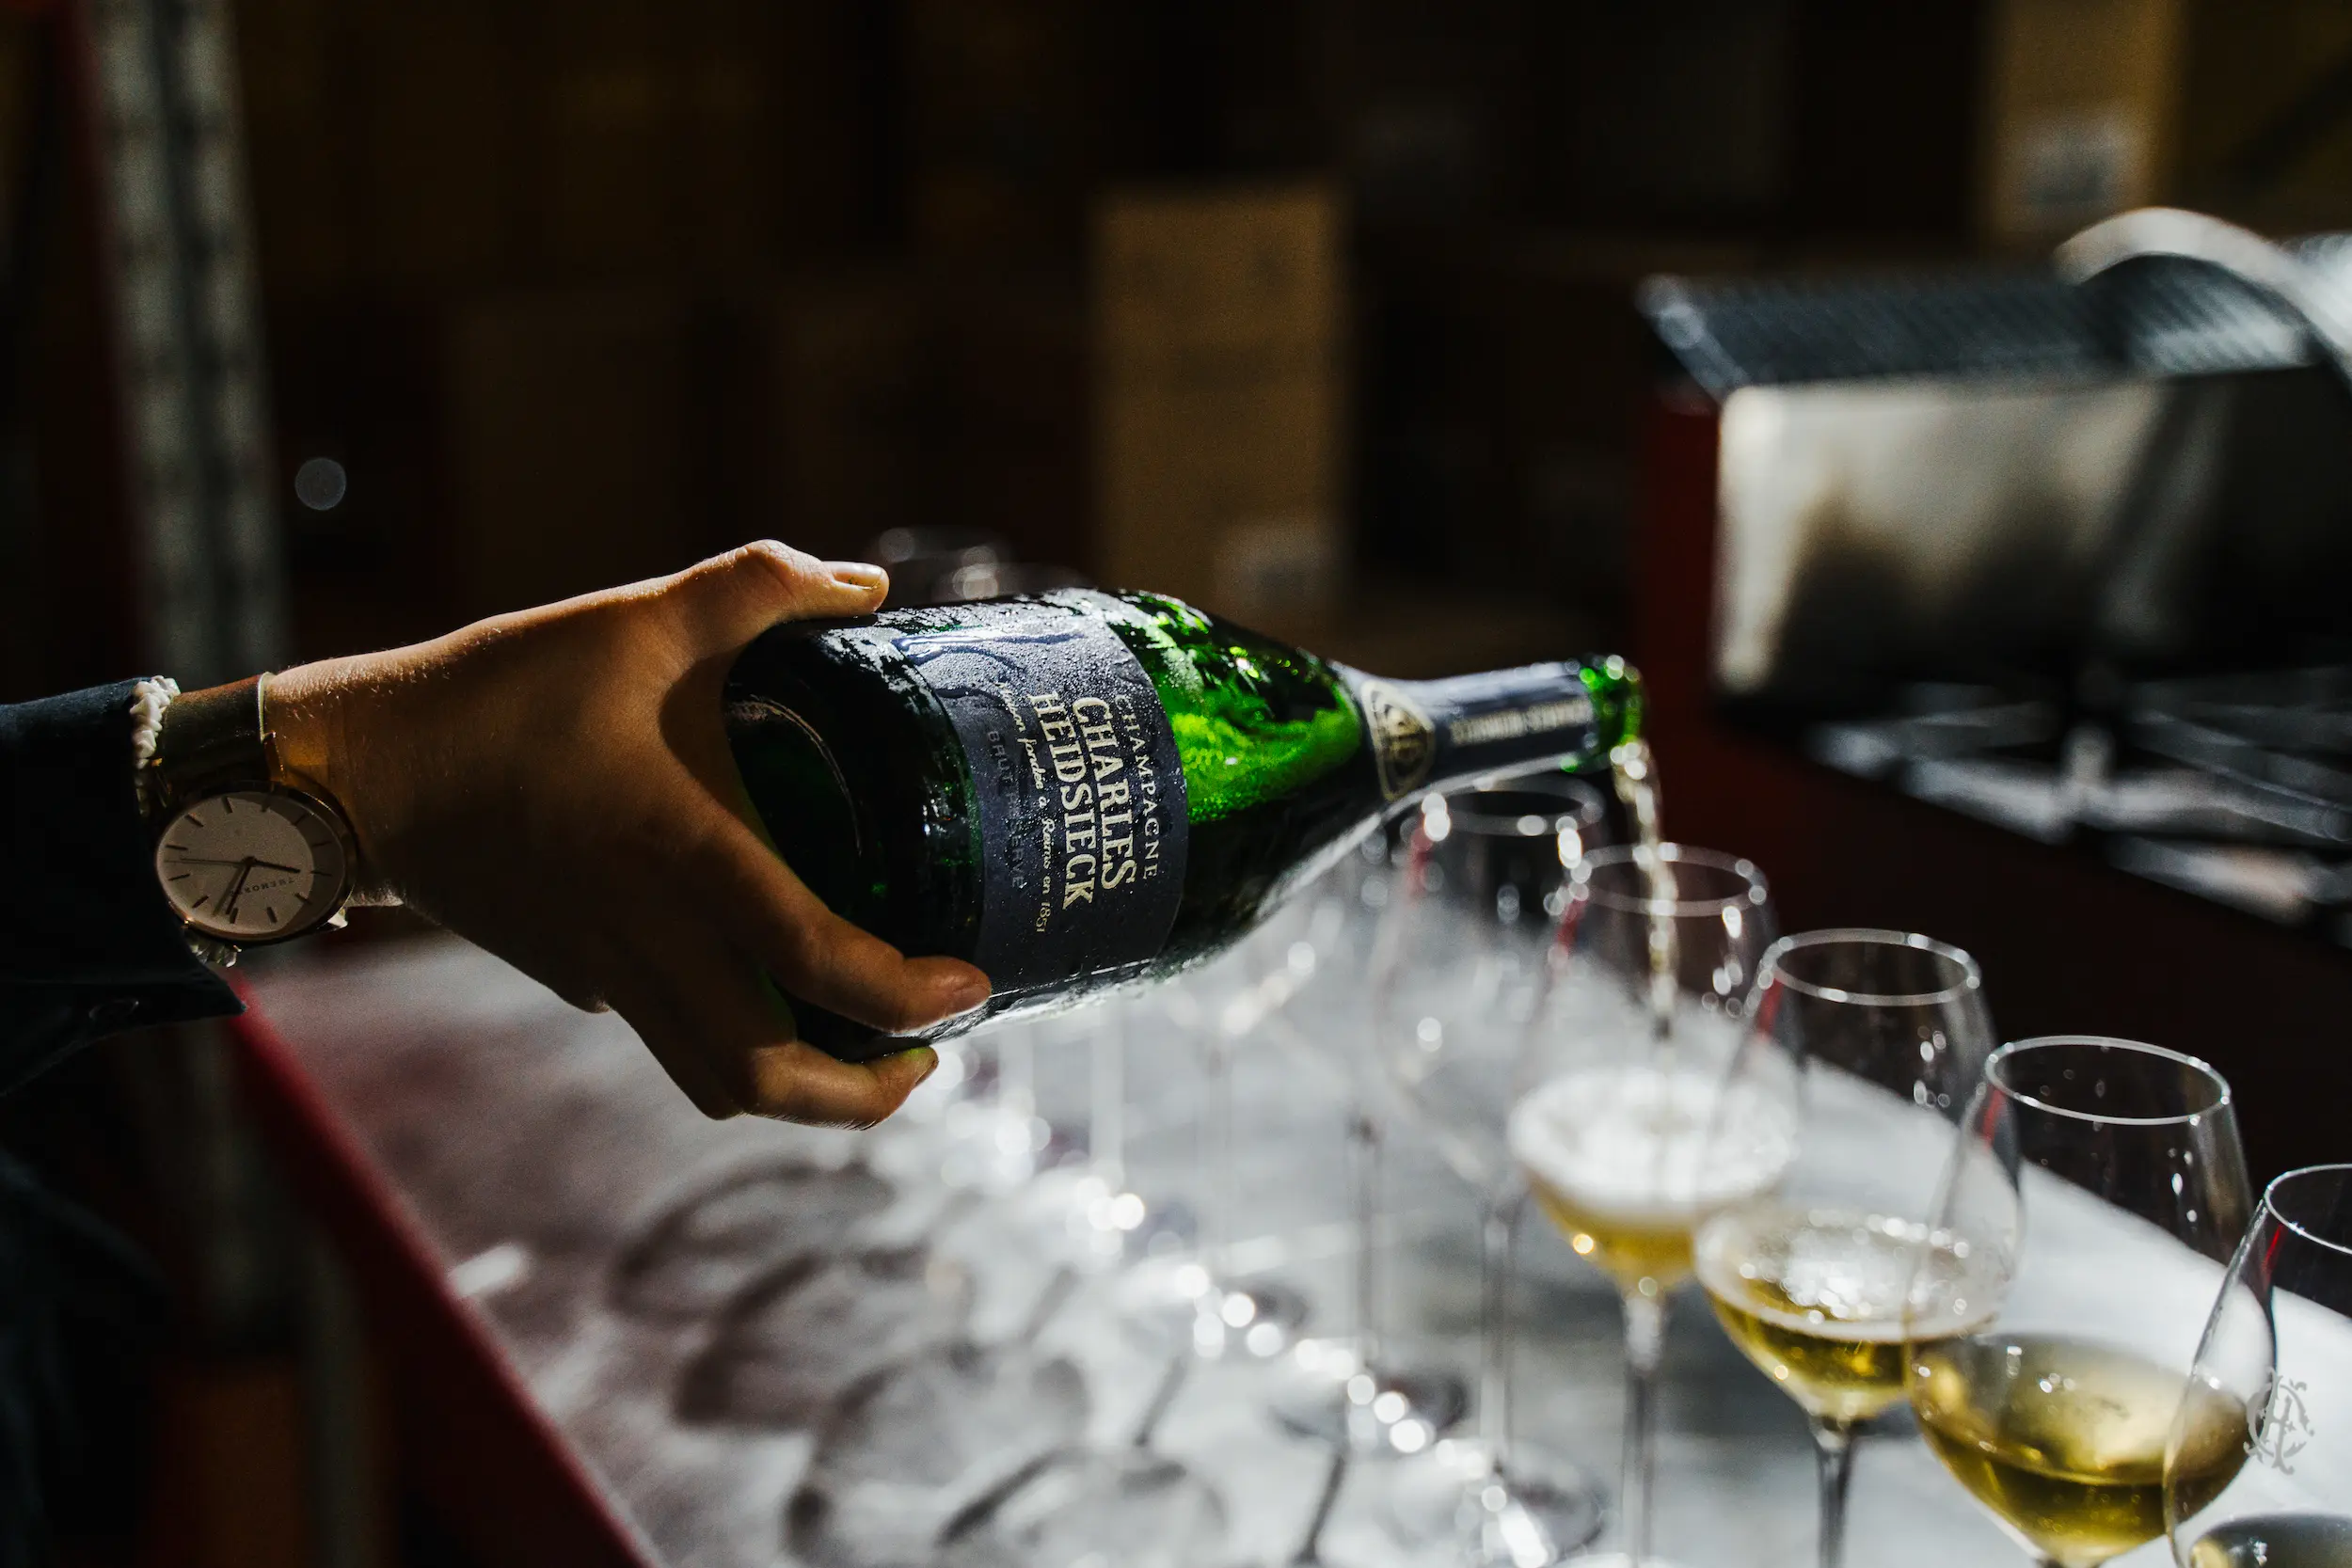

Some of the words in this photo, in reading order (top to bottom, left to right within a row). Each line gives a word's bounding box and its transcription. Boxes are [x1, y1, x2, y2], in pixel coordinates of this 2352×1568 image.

[987, 731, 1014, 784] BRUT
[1027, 691, 1097, 911] HEIDSIECK
[1073, 697, 1136, 890] CHARLES
[1115, 695, 1160, 879] CHAMPAGNE
[1041, 818, 1056, 869] Reims
[1041, 876, 1051, 895] en
[1037, 902, 1053, 933] 1851
